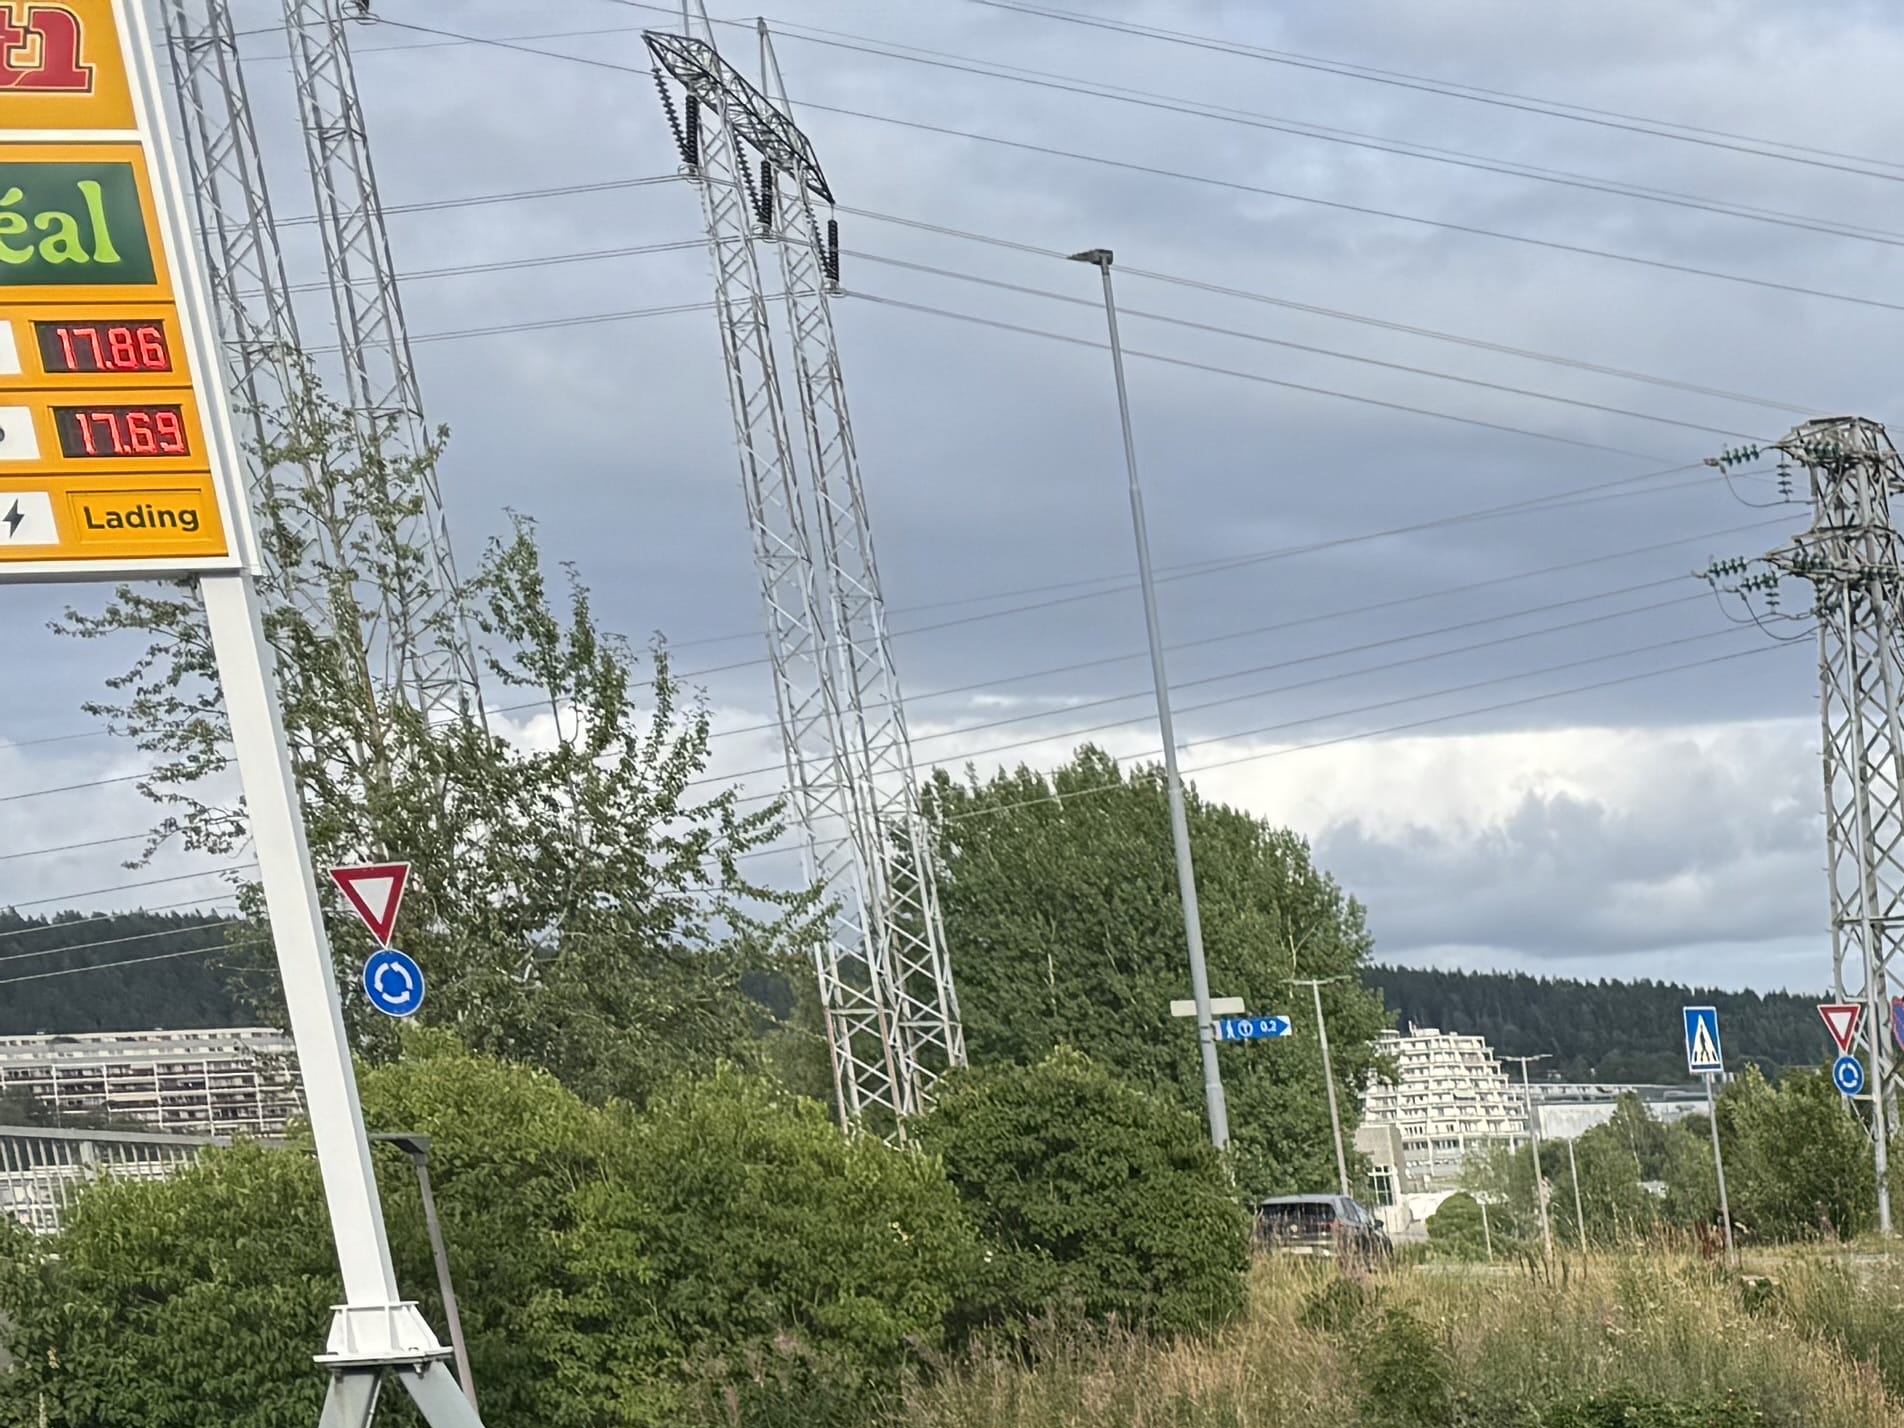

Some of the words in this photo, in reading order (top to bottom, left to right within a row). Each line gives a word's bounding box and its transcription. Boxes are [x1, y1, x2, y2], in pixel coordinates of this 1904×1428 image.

[56, 326, 167, 370] 17.86
[75, 411, 186, 455] 17.69
[83, 503, 200, 532] Lading
